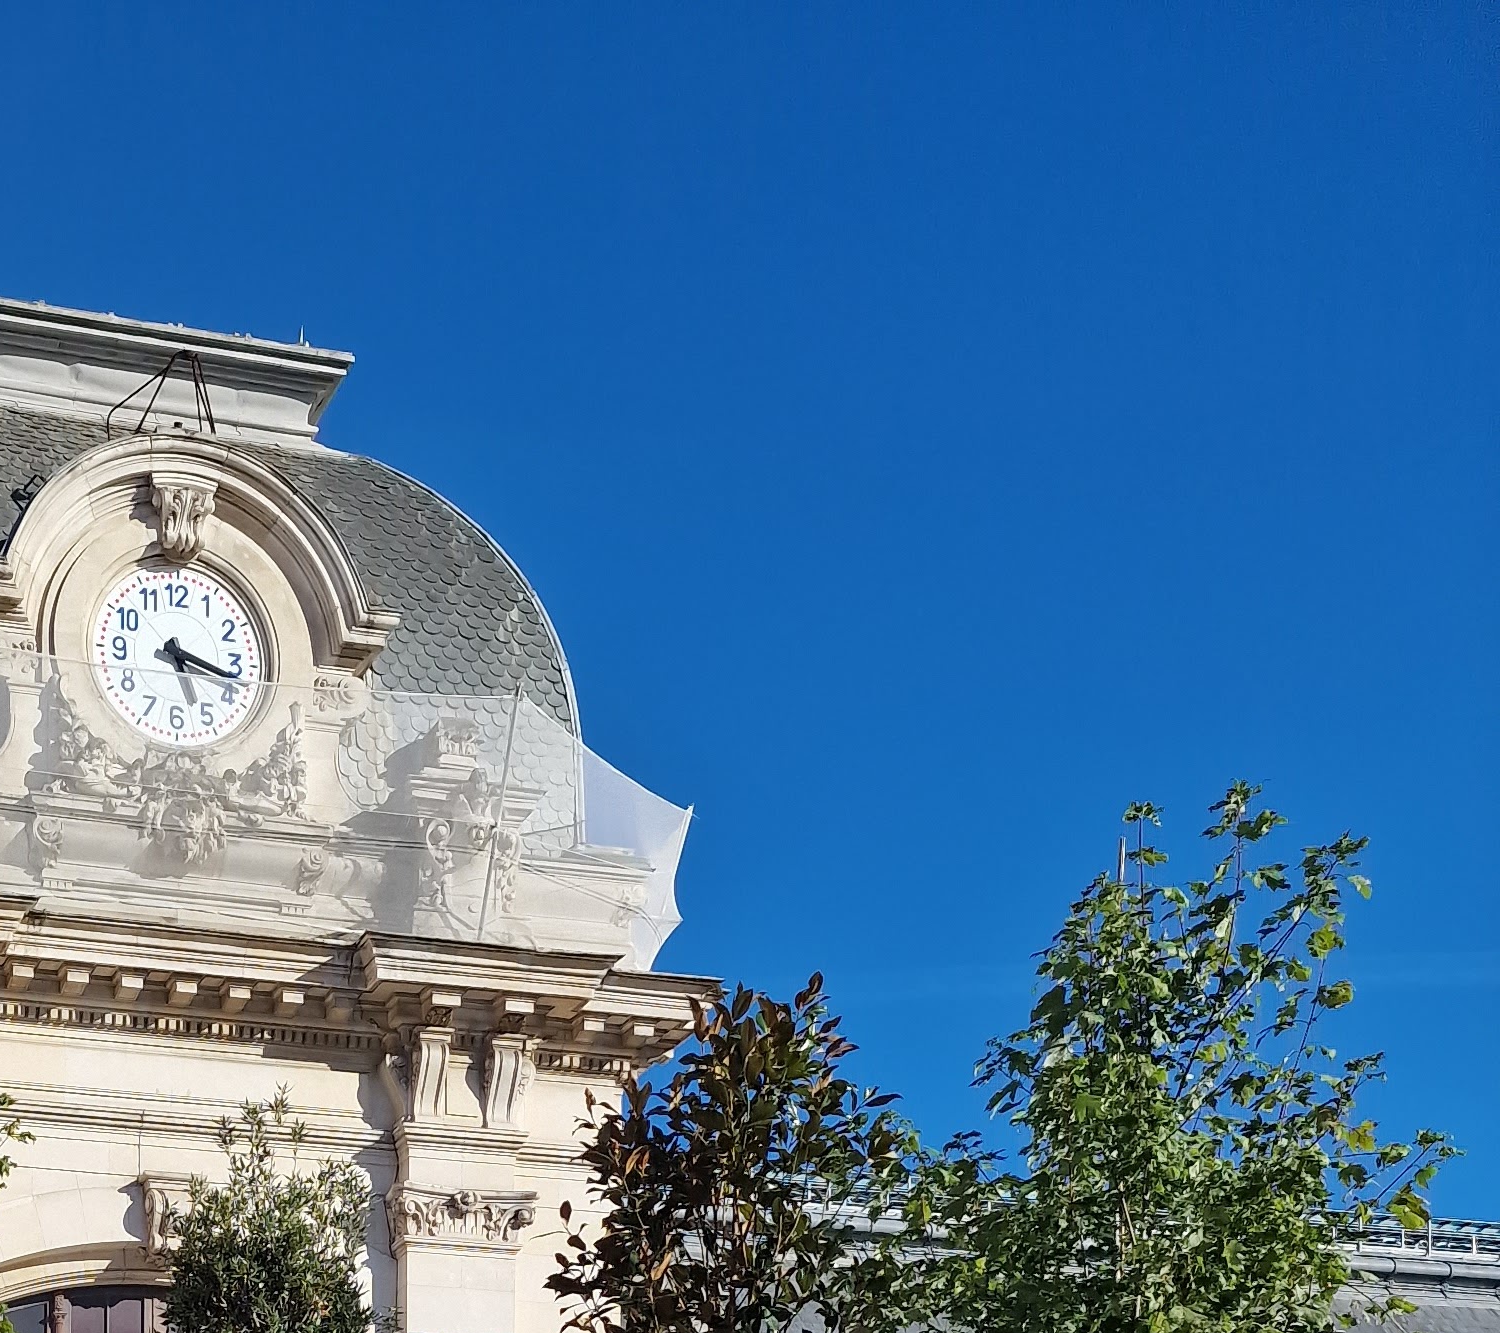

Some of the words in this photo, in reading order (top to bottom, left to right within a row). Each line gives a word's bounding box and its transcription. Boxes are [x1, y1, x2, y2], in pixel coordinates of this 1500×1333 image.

[138, 587, 158, 613] 11
[164, 583, 189, 609] 12
[200, 594, 210, 618] 1
[116, 607, 139, 632] 10
[221, 619, 237, 643] 2
[112, 635, 127, 660] 9
[227, 652, 243, 678] 3
[120, 667, 135, 692] 8
[142, 694, 157, 717] 7
[220, 682, 236, 706] 4
[169, 705, 184, 730] 6
[200, 702, 214, 727] 5
